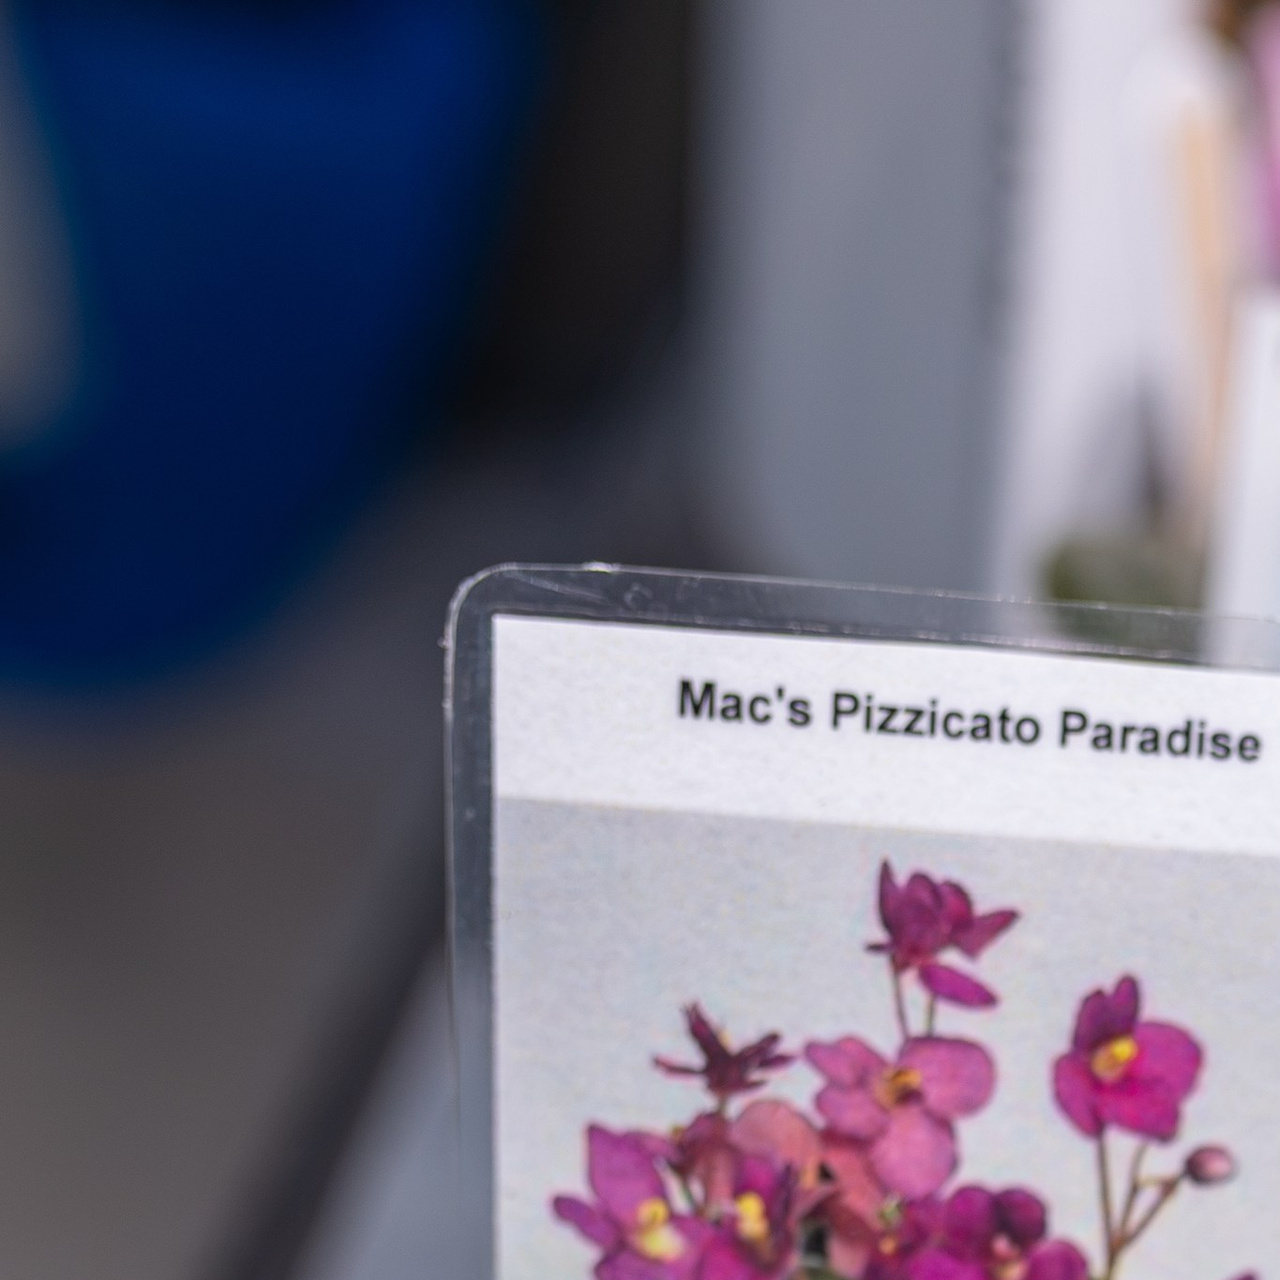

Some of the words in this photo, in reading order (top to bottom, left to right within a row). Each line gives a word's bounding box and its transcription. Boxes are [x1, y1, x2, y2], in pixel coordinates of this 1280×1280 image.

[677, 677, 813, 729] Mac's
[830, 690, 1042, 746] Pizzicato
[1058, 709, 1263, 763] Paradise
